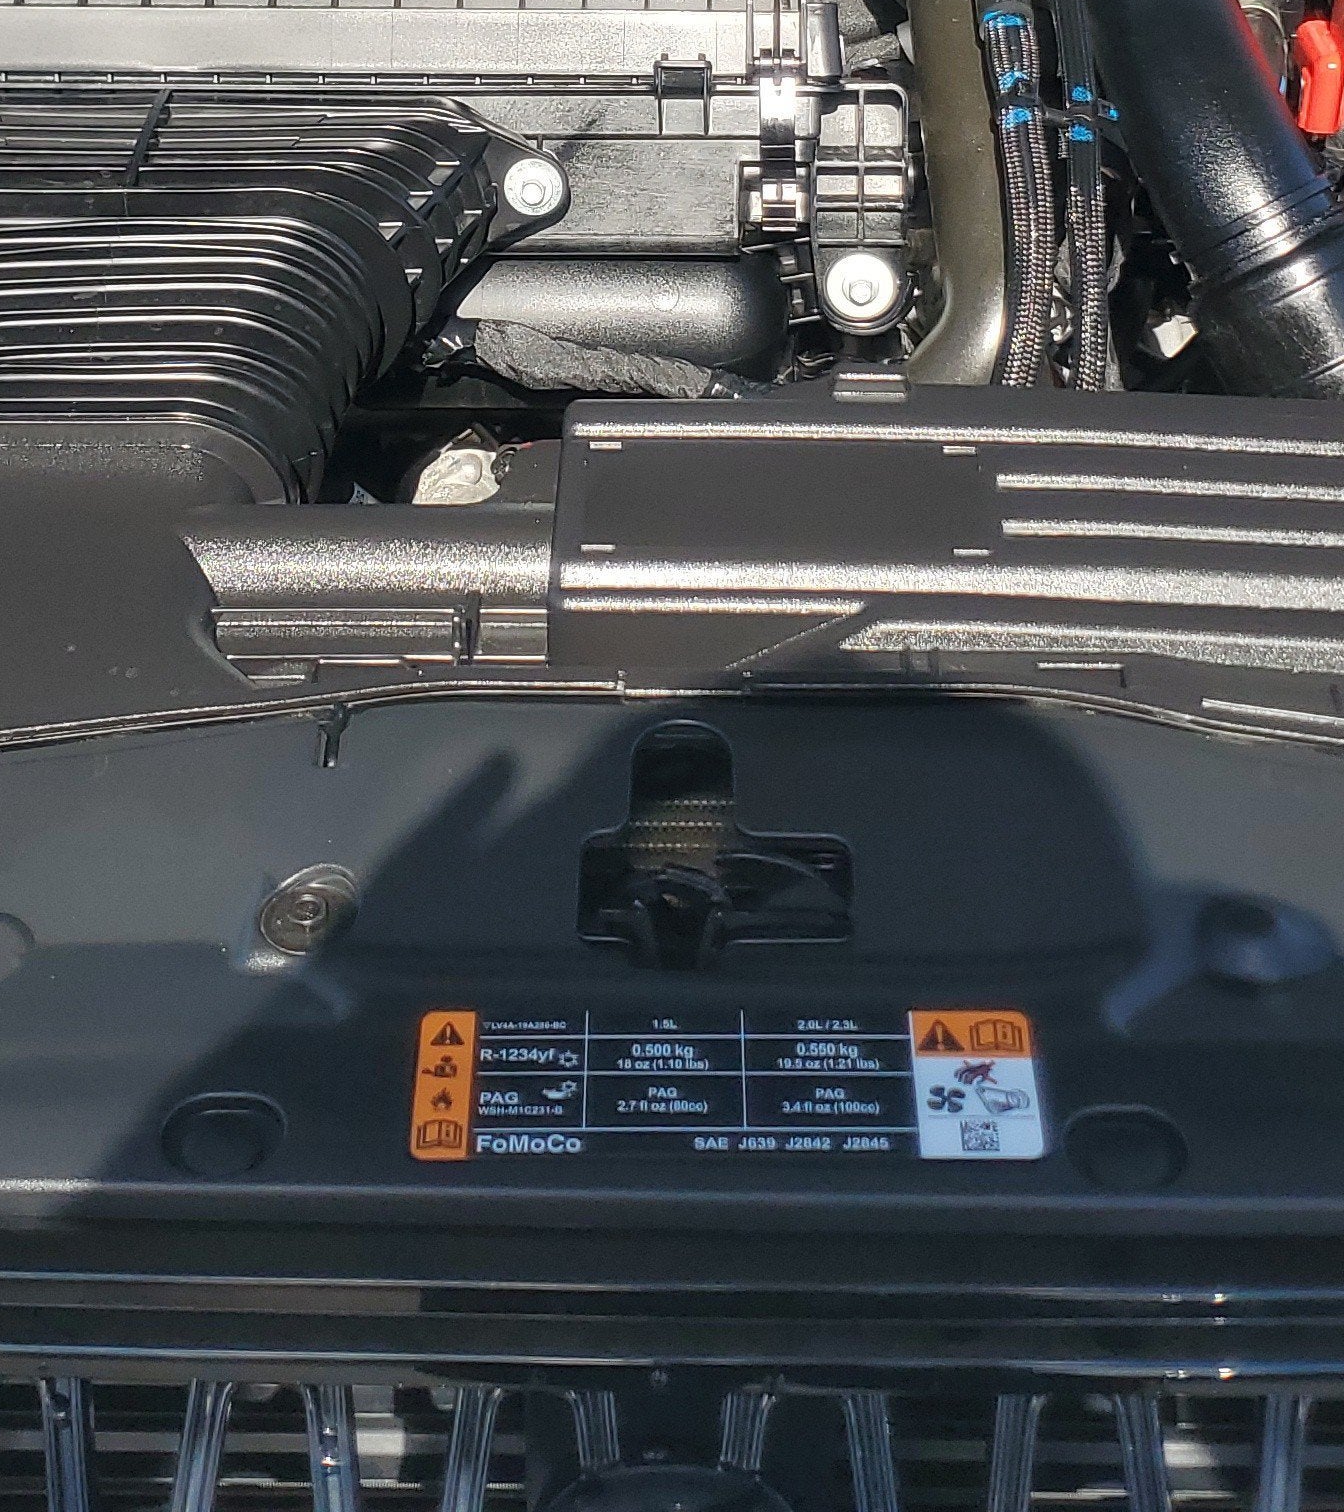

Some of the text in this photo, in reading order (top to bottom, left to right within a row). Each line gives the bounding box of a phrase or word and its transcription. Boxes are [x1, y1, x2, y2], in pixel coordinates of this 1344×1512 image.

[652, 1018, 678, 1029] 1.5L
[797, 1019, 823, 1030] 2.0L
[832, 1019, 858, 1030] 2.3L
[480, 1048, 555, 1065] R-1234yf
[631, 1043, 695, 1059] 0.500 kg
[796, 1042, 859, 1059] 0.550 kg
[616, 1057, 710, 1071] 18 oz (1.10 lbs)
[805, 1060, 822, 1069] oz
[823, 1058, 853, 1071] (1.21
[856, 1057, 880, 1070] lbs)
[479, 1091, 520, 1105] PAG
[648, 1087, 678, 1098] PAG
[815, 1087, 846, 1099] PAG
[616, 1099, 637, 1113] 2.7
[639, 1100, 648, 1112] fl
[650, 1102, 666, 1112] oz
[781, 1100, 880, 1115] 3.4 fl oz (100cc)
[476, 1133, 582, 1155] FoMoCo
[694, 1137, 729, 1150] SAE
[737, 1136, 777, 1150] J639
